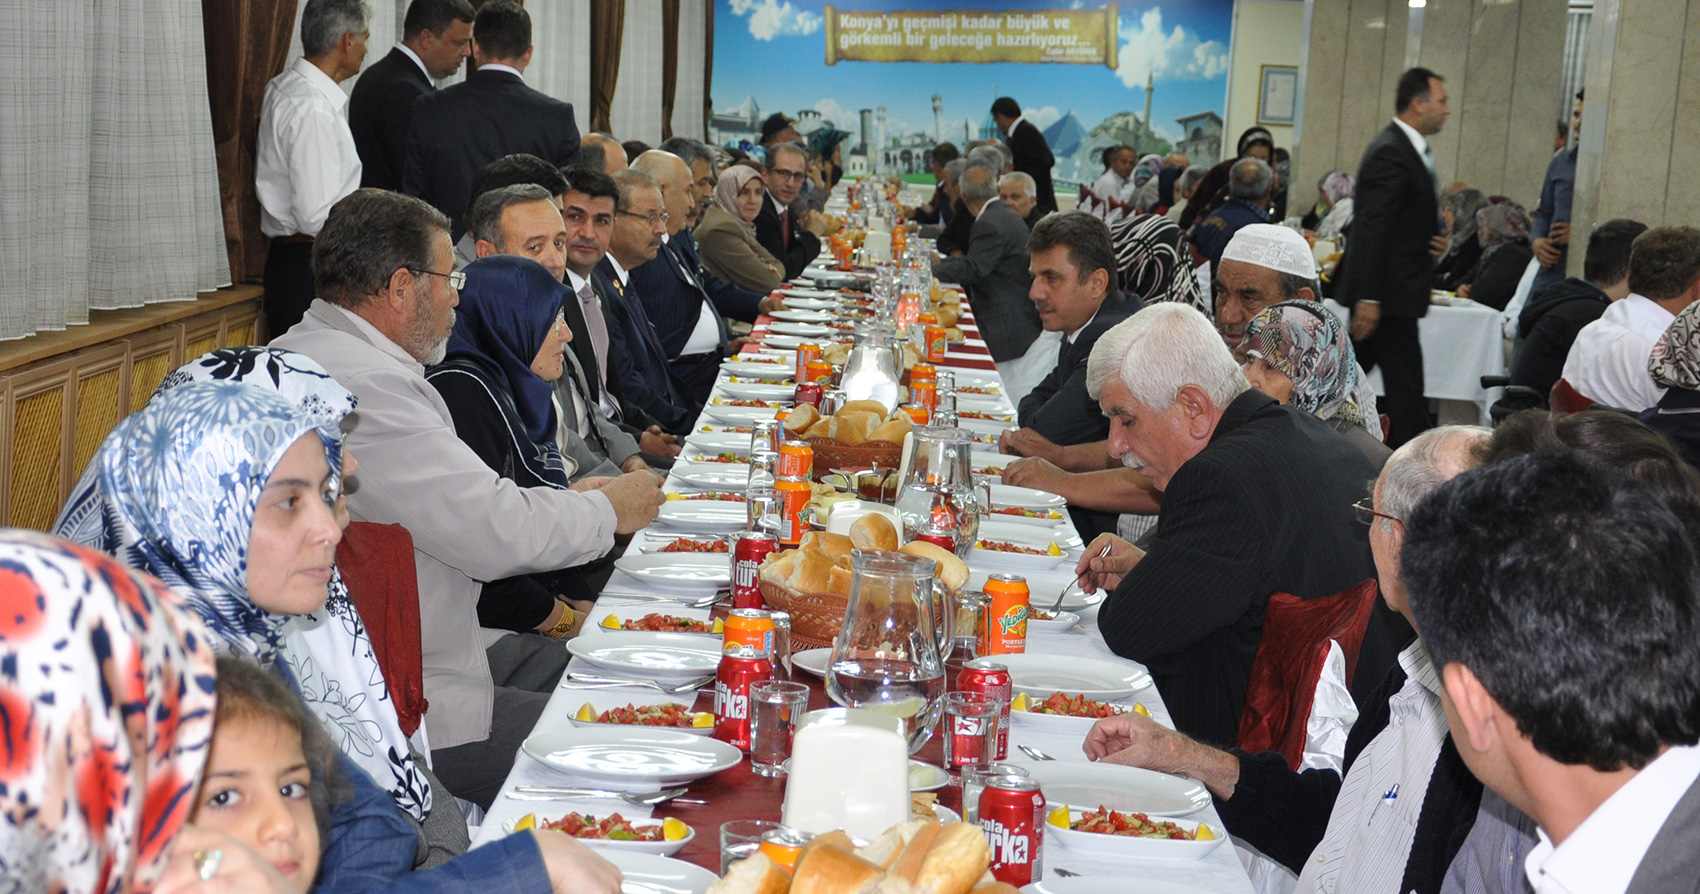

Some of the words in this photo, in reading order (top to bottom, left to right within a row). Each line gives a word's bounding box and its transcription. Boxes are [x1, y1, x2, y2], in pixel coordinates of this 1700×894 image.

[840, 14, 899, 32] Konya'yı
[902, 14, 957, 32] geçmişi
[961, 14, 1002, 29] kadar
[1006, 13, 1050, 32] büyük
[1053, 17, 1070, 29] ve
[840, 30, 902, 50] görkemli
[905, 31, 926, 46] bir
[929, 31, 993, 50] geleceğe
[739, 559, 758, 569] cola
